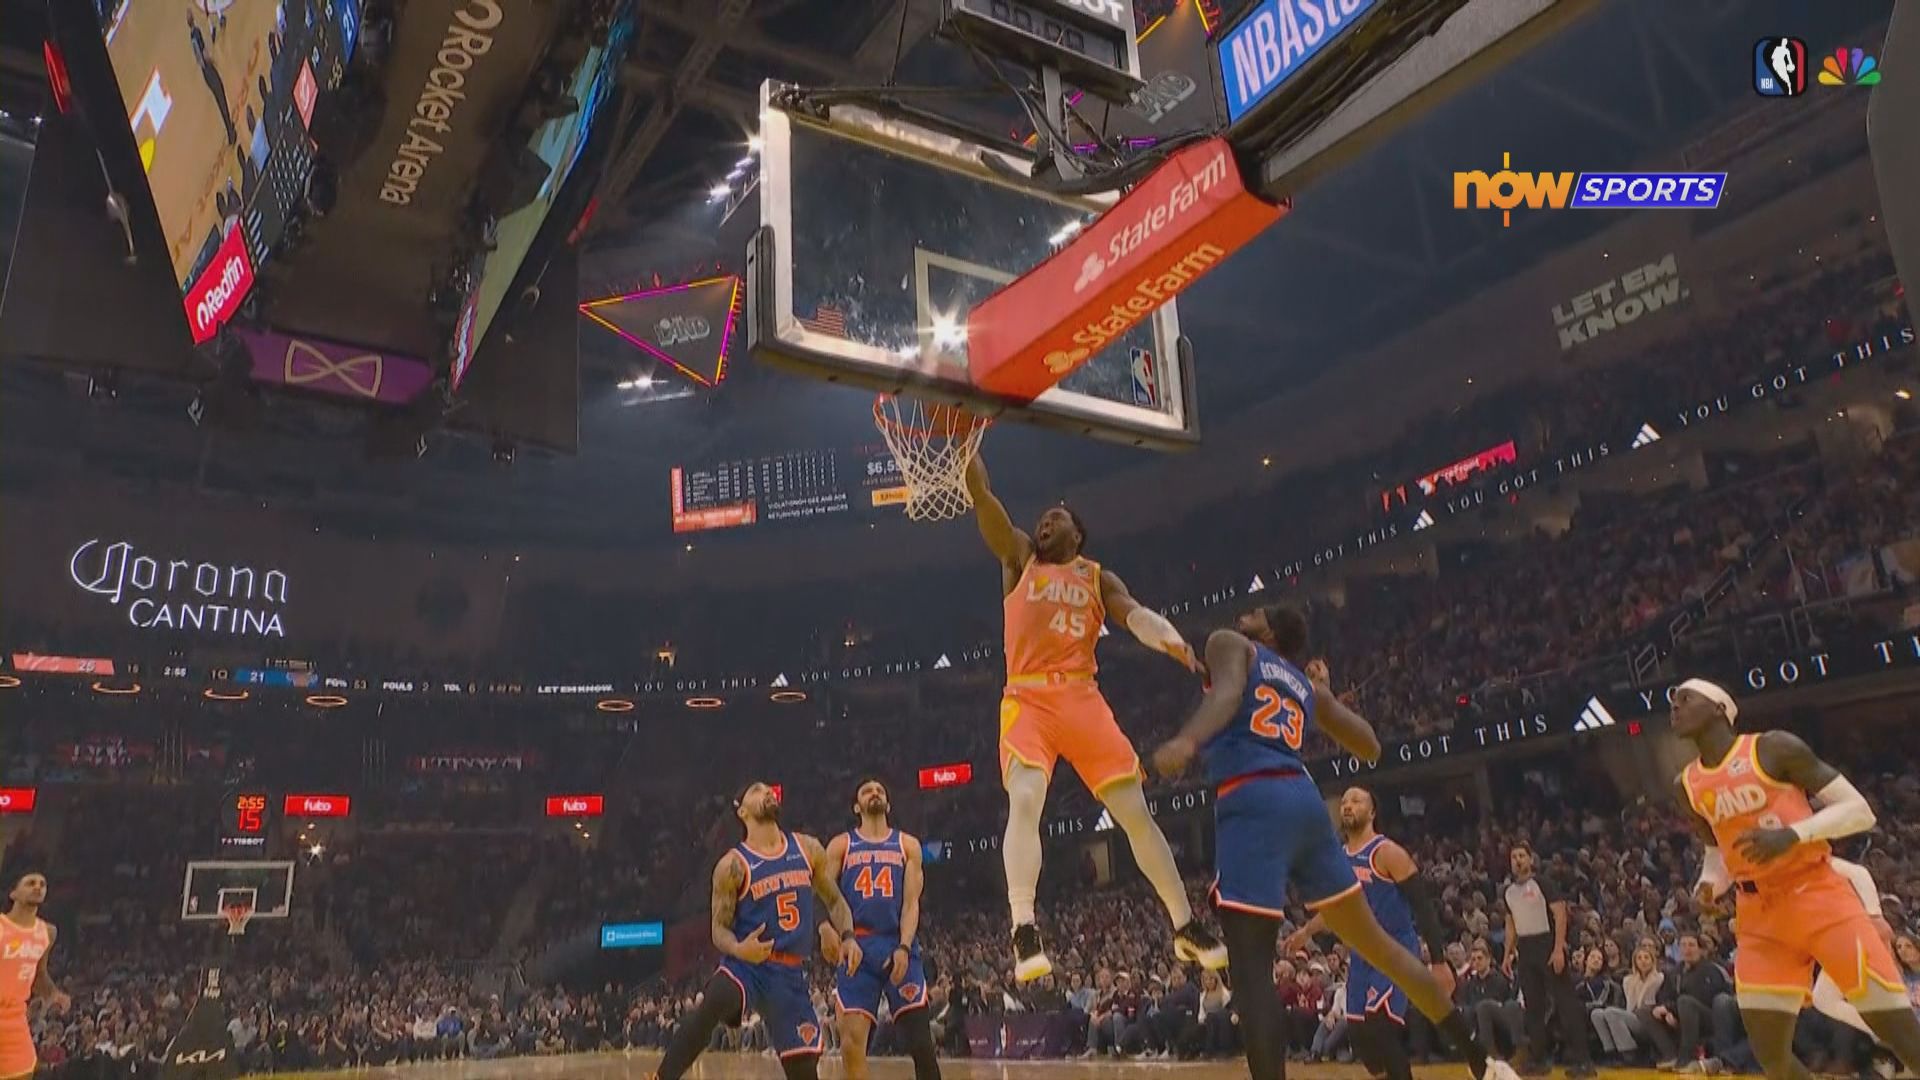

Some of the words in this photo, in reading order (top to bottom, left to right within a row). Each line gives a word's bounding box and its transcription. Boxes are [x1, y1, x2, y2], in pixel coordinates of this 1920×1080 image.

[410, 25, 494, 134] Rocket
[378, 127, 444, 206] Arena
[205, 255, 245, 320] Redfin
[1551, 279, 1617, 326] LET
[1620, 252, 1678, 294] EM
[1677, 395, 1729, 427] YOU
[1751, 365, 1808, 399] GOT
[1832, 327, 1915, 368] THIS
[1447, 490, 1484, 514] YOU
[1499, 469, 1537, 495] GOT
[1554, 442, 1609, 473] THIS
[1274, 559, 1302, 580] YOU
[1313, 544, 1343, 566] GOT
[1357, 523, 1398, 550] THIS
[70, 538, 287, 604] Corona
[1025, 577, 1090, 609] LAND
[1202, 585, 1236, 608] THIS
[129, 598, 284, 638] CANTINA
[1048, 607, 1087, 640] 45
[800, 671, 831, 683] YOU
[842, 666, 874, 680] GOT
[885, 659, 922, 675] THIS
[962, 648, 993, 663] YOU
[1747, 652, 1830, 690] GOT
[250, 671, 265, 683] 21
[633, 681, 666, 692] YOU
[676, 680, 708, 691] GOT
[720, 677, 759, 690] THIS
[1249, 683, 1305, 750] 23
[1399, 734, 1450, 762] GOT
[1474, 713, 1549, 746] THIS
[303, 798, 332, 812] fubo
[562, 799, 588, 812] fubo
[1171, 789, 1208, 811] GOT
[239, 809, 261, 831] 15
[1048, 819, 1084, 837] THIS
[968, 835, 999, 852] YOU
[854, 865, 894, 899] 44
[776, 891, 800, 932] 5
